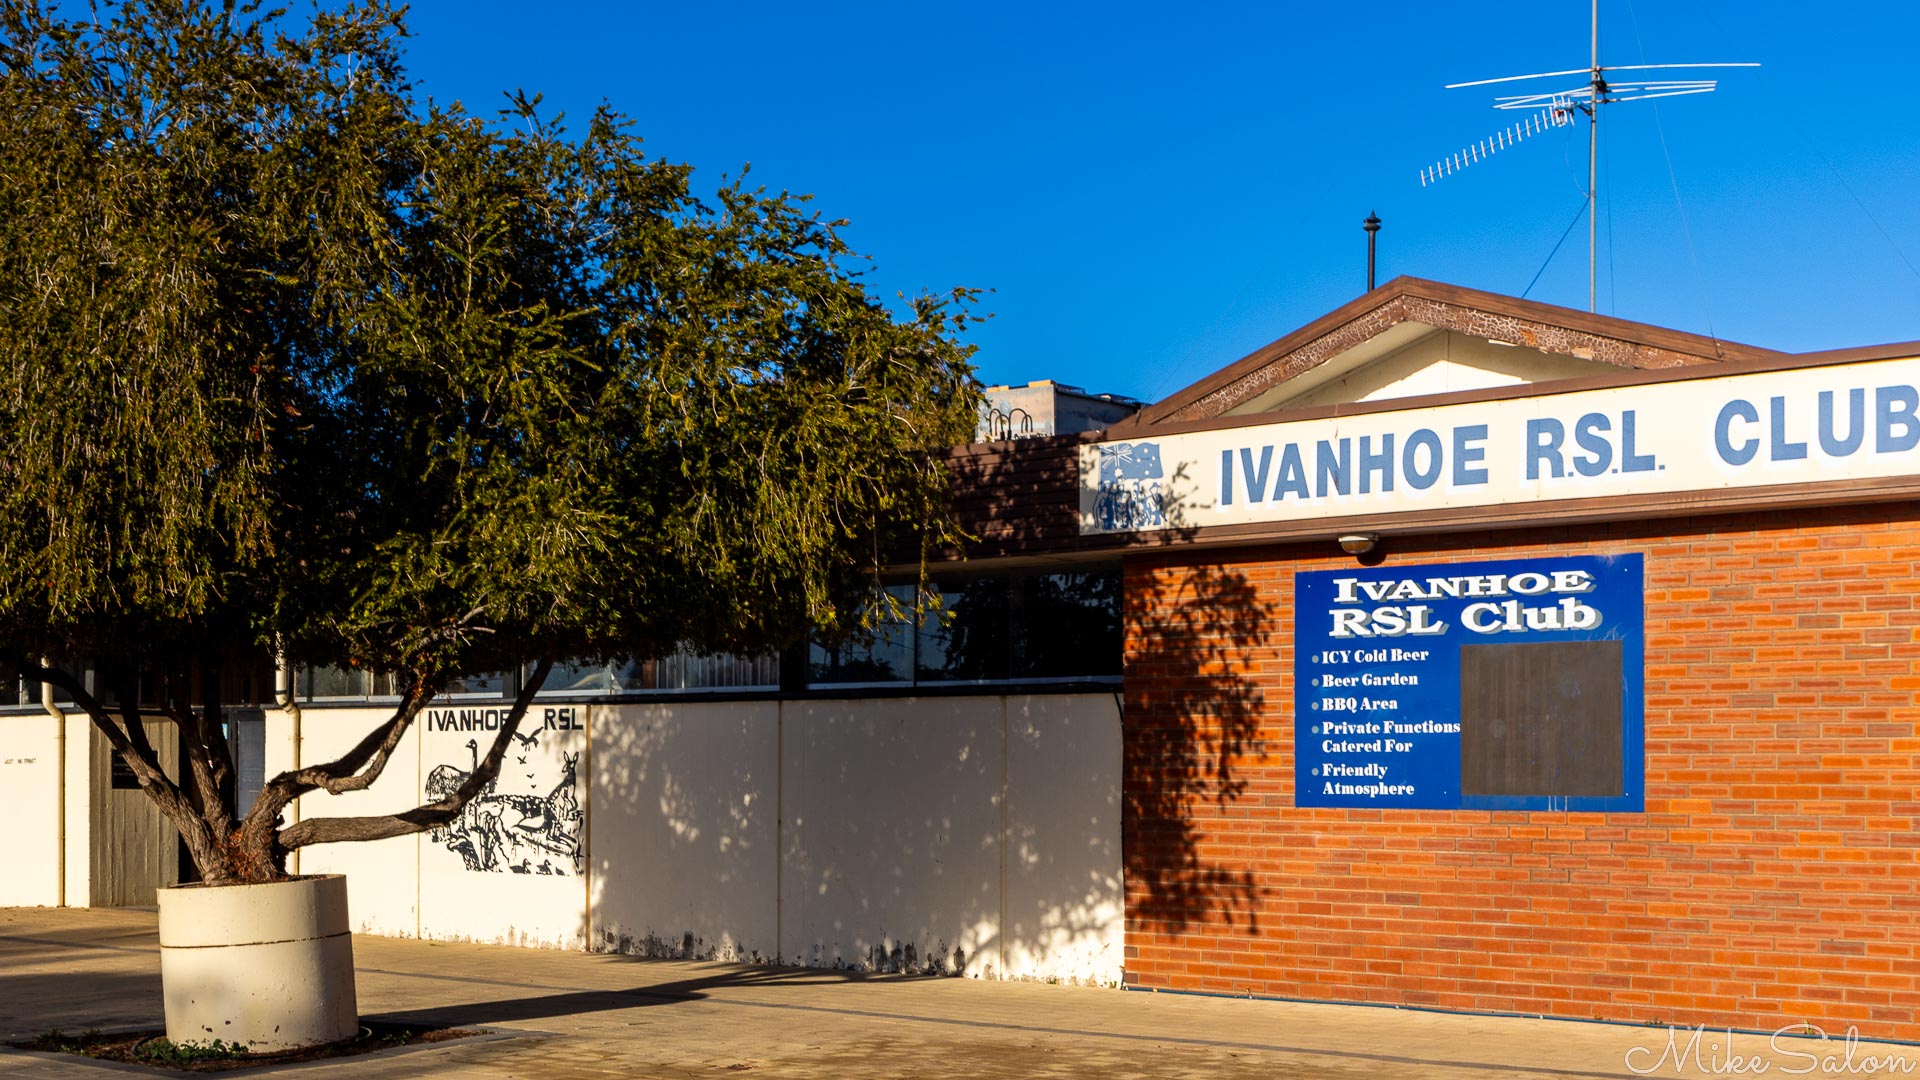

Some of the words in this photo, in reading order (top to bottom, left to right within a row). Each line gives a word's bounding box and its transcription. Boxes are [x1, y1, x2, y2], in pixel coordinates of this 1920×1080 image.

[1222, 424, 1488, 506] IVANHOE
[1526, 410, 1666, 480] R.S.L.
[1714, 384, 1920, 466] CLUB
[1333, 570, 1595, 604] IVANHOE
[1329, 605, 1447, 639] RSL
[1461, 597, 1600, 634] Club
[1322, 650, 1351, 664] ICY
[1354, 649, 1387, 663] Cold
[1390, 648, 1430, 662] Beer
[1322, 674, 1359, 688] Beer
[1361, 672, 1418, 686] Garden
[1322, 697, 1358, 713] BBQ
[1360, 697, 1398, 710] Area
[544, 708, 583, 730] RSL
[1322, 721, 1381, 735] Private
[1383, 719, 1461, 734] Functions
[1322, 739, 1382, 753] Catered
[1384, 738, 1413, 753] For
[1322, 763, 1388, 779] Friendly
[1322, 781, 1415, 798] Atmosphere
